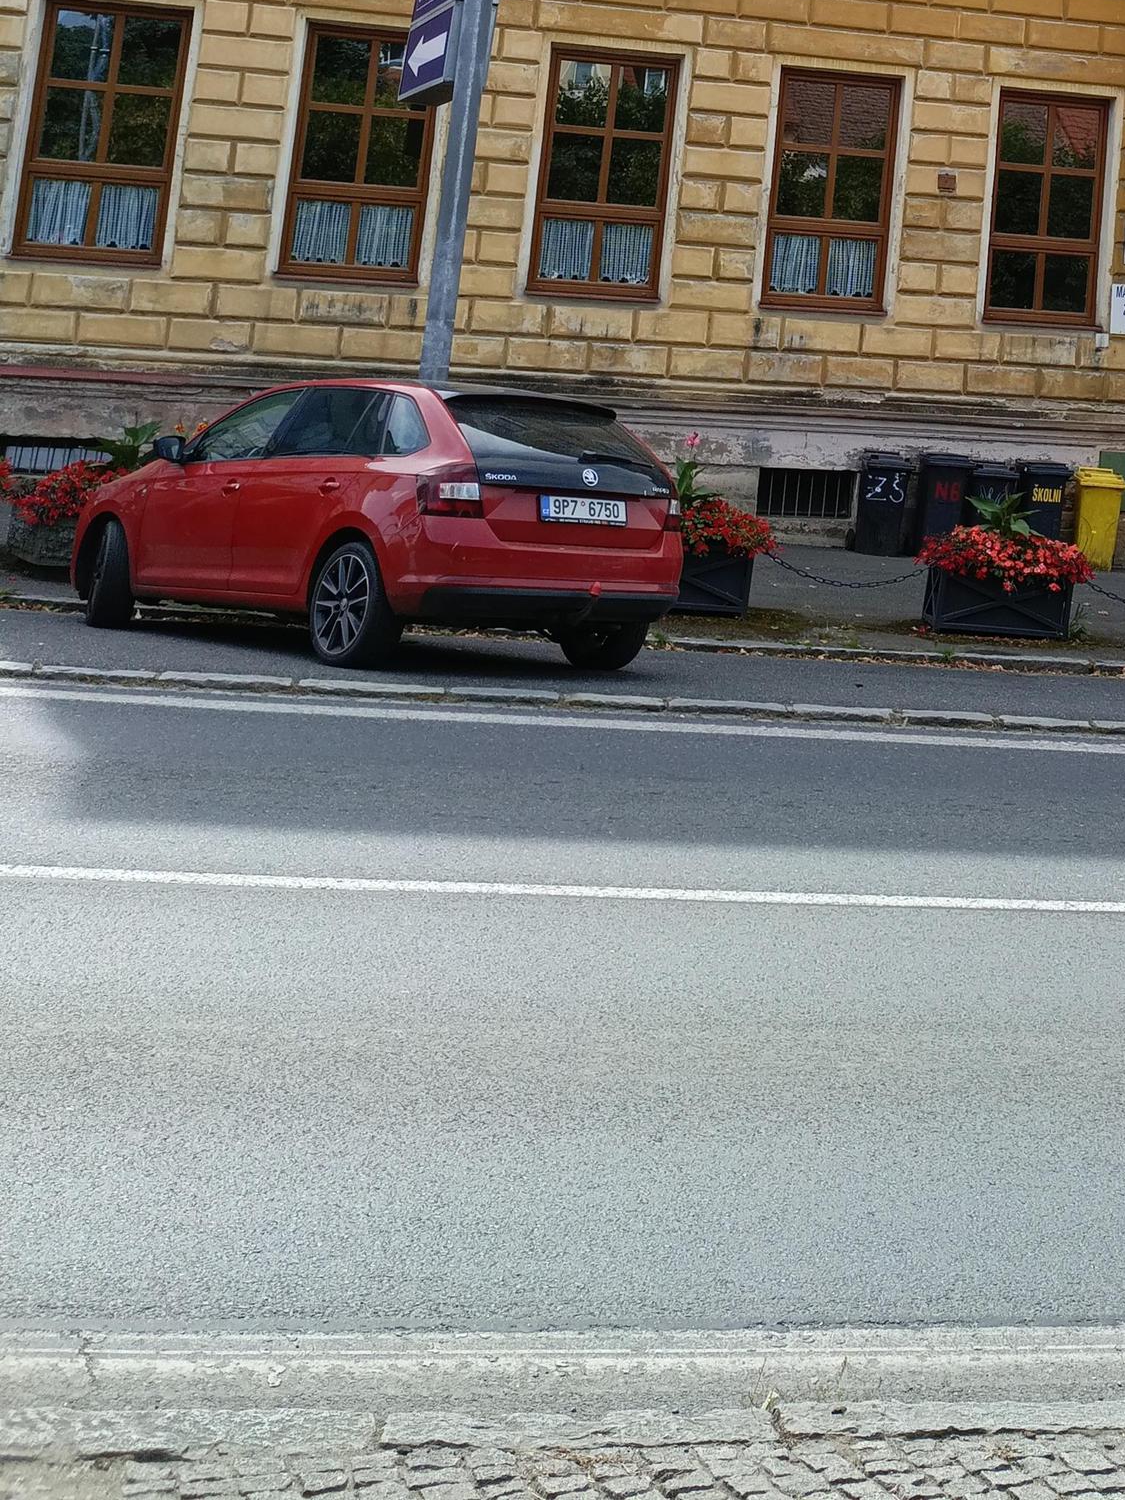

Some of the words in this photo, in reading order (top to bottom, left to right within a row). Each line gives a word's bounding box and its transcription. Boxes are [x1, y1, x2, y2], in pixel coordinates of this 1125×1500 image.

[485, 473, 517, 481] ŠKODA
[1032, 484, 1063, 503] ŠKOLNÍ
[553, 498, 578, 516] 9P7
[588, 501, 620, 519] 6750
